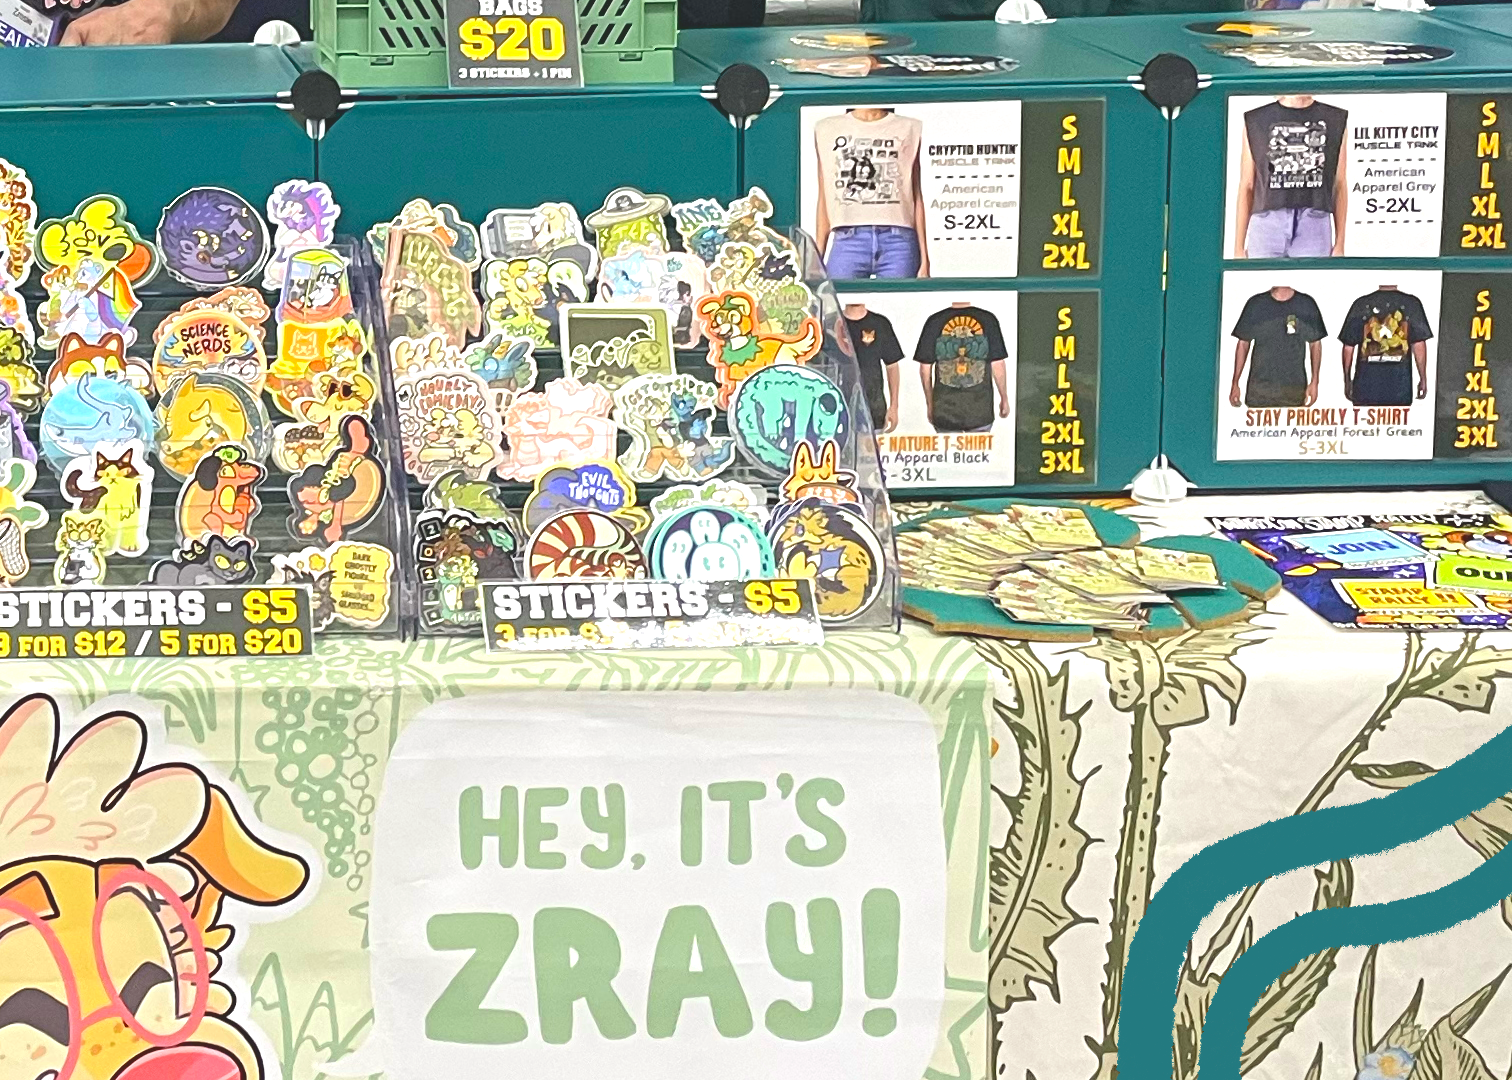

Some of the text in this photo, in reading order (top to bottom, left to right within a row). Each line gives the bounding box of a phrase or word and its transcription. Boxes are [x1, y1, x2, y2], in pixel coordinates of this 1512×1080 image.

[458, 17, 566, 62] $20
[458, 67, 468, 79] 3
[469, 67, 531, 79] STICKERS
[1062, 115, 1078, 141] S
[1354, 126, 1439, 140] LIL KITTY CITY
[928, 145, 974, 156] CRYPTID
[1354, 141, 1439, 150] MUSCLE TANK
[931, 157, 1016, 167] MUSCLE TANK
[1057, 147, 1081, 175] M
[942, 184, 1003, 195] American
[1061, 178, 1076, 207] L
[930, 199, 1017, 211] Apparel Cream
[944, 214, 1000, 230] S-2XL
[1052, 210, 1084, 238] XL
[1042, 242, 1090, 270] 2XL
[181, 324, 230, 341] SCIENCE
[182, 339, 231, 355] NERDS
[419, 378, 472, 396] HOURLY
[1246, 407, 1411, 427] STAY PRICKLY T-SHIRT
[1230, 427, 1423, 439] American Apparel Forest Green
[889, 434, 995, 452] NATURE T-SHIRT
[1298, 441, 1349, 455] S-3XL
[582, 470, 610, 487] EVIL
[568, 483, 620, 506] THOUGHTS
[1326, 539, 1400, 557] JOIN
[1356, 586, 1422, 597] STAMP
[1369, 594, 1430, 605] RALLY
[243, 590, 298, 624] $5
[458, 772, 849, 874] HEY, IT'S
[424, 887, 903, 1048] ZRAY!
